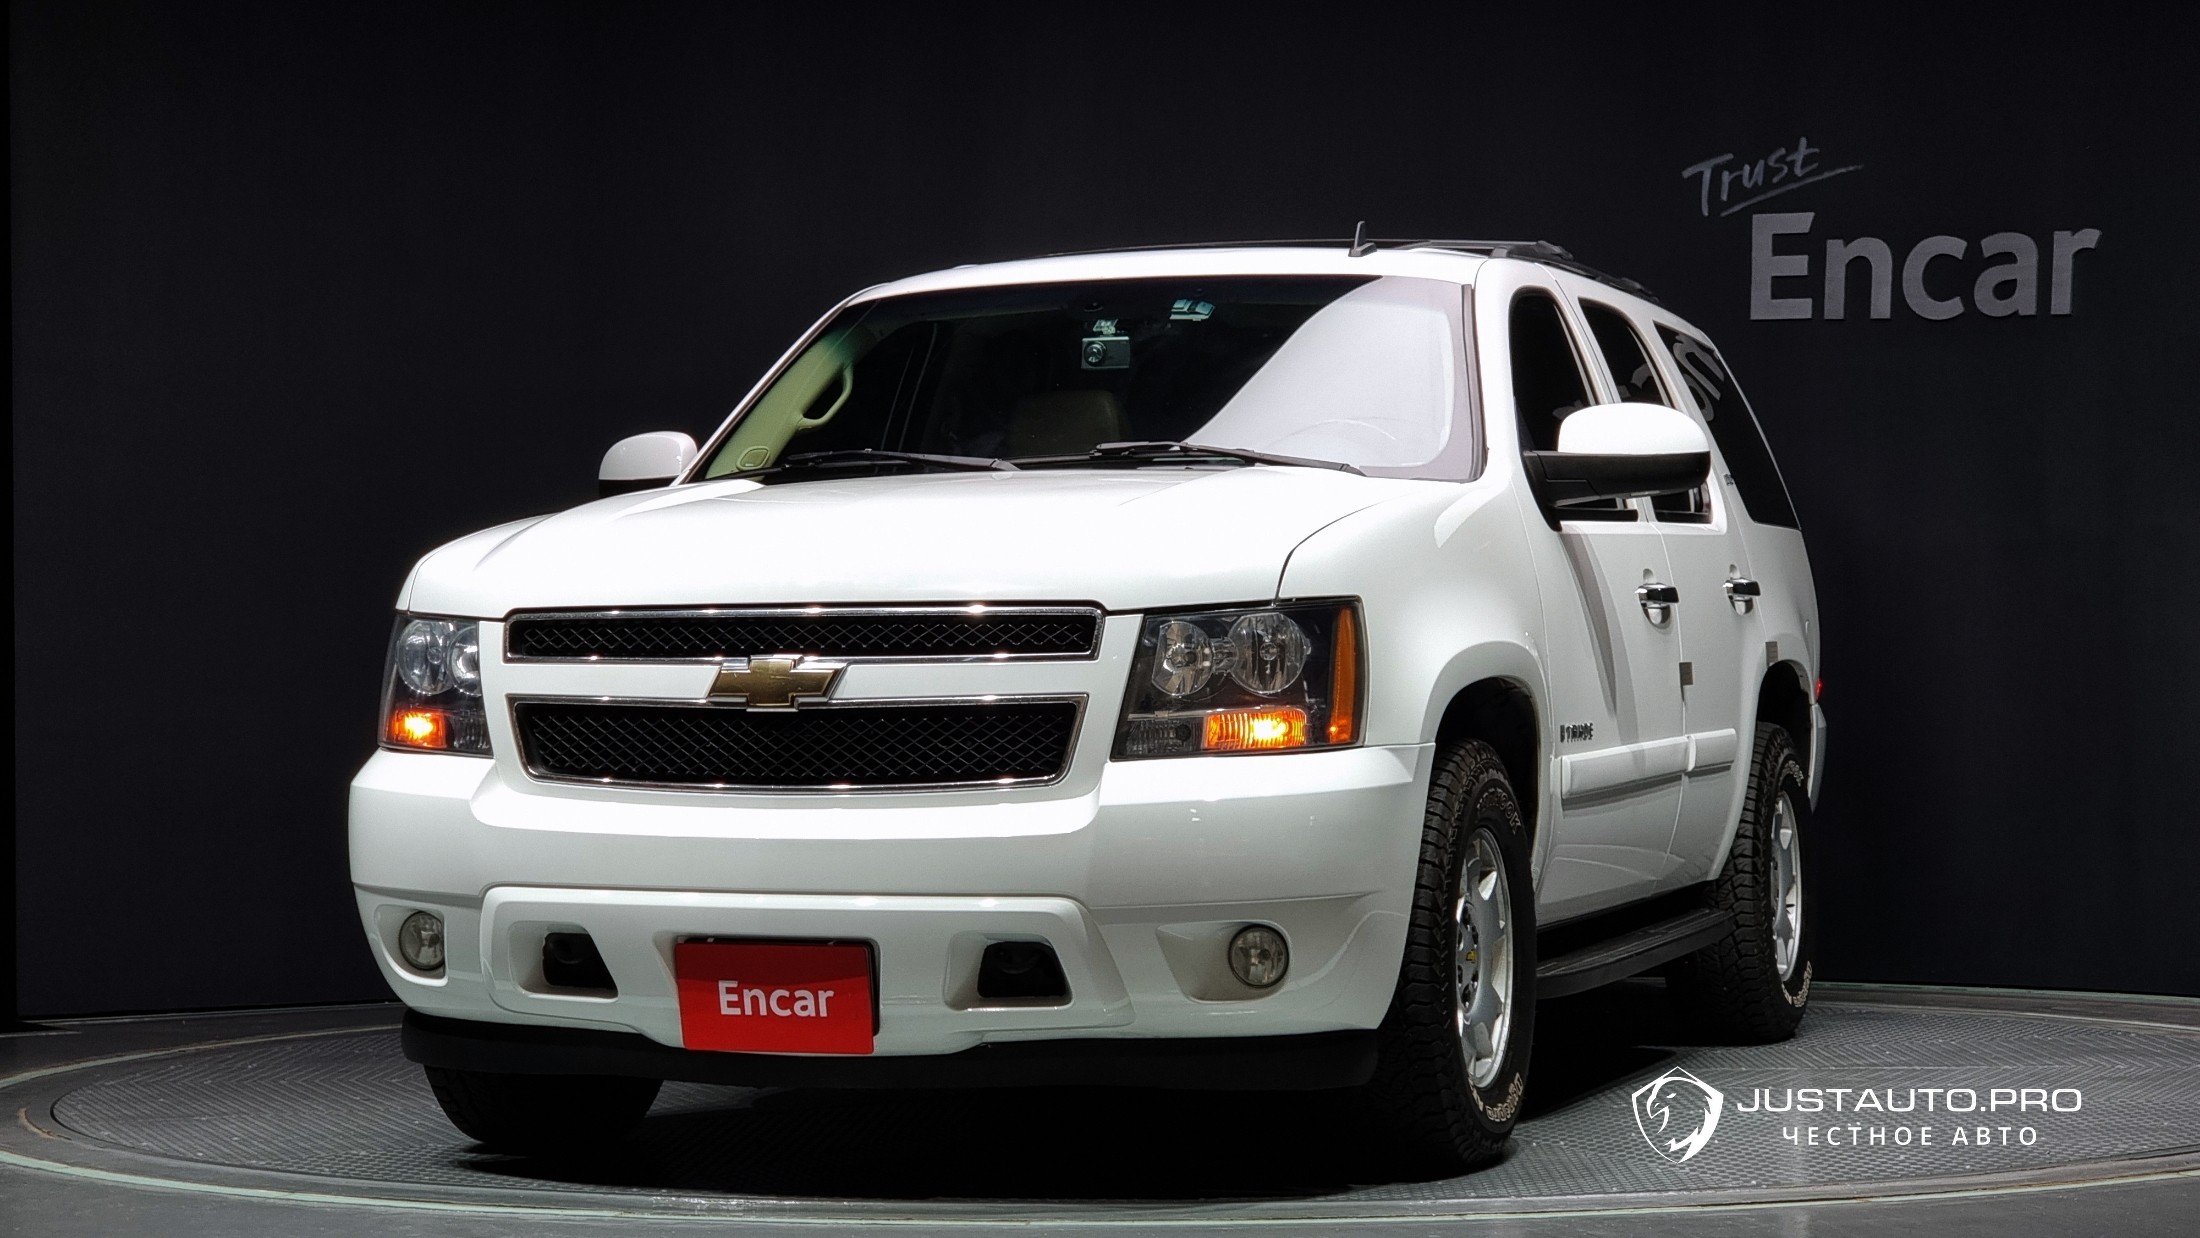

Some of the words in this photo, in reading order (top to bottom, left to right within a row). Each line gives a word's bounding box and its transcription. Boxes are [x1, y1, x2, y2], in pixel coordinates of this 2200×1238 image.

[1682, 137, 1820, 216] Trust
[1750, 211, 2102, 321] Encar
[718, 980, 835, 1017] Encar
